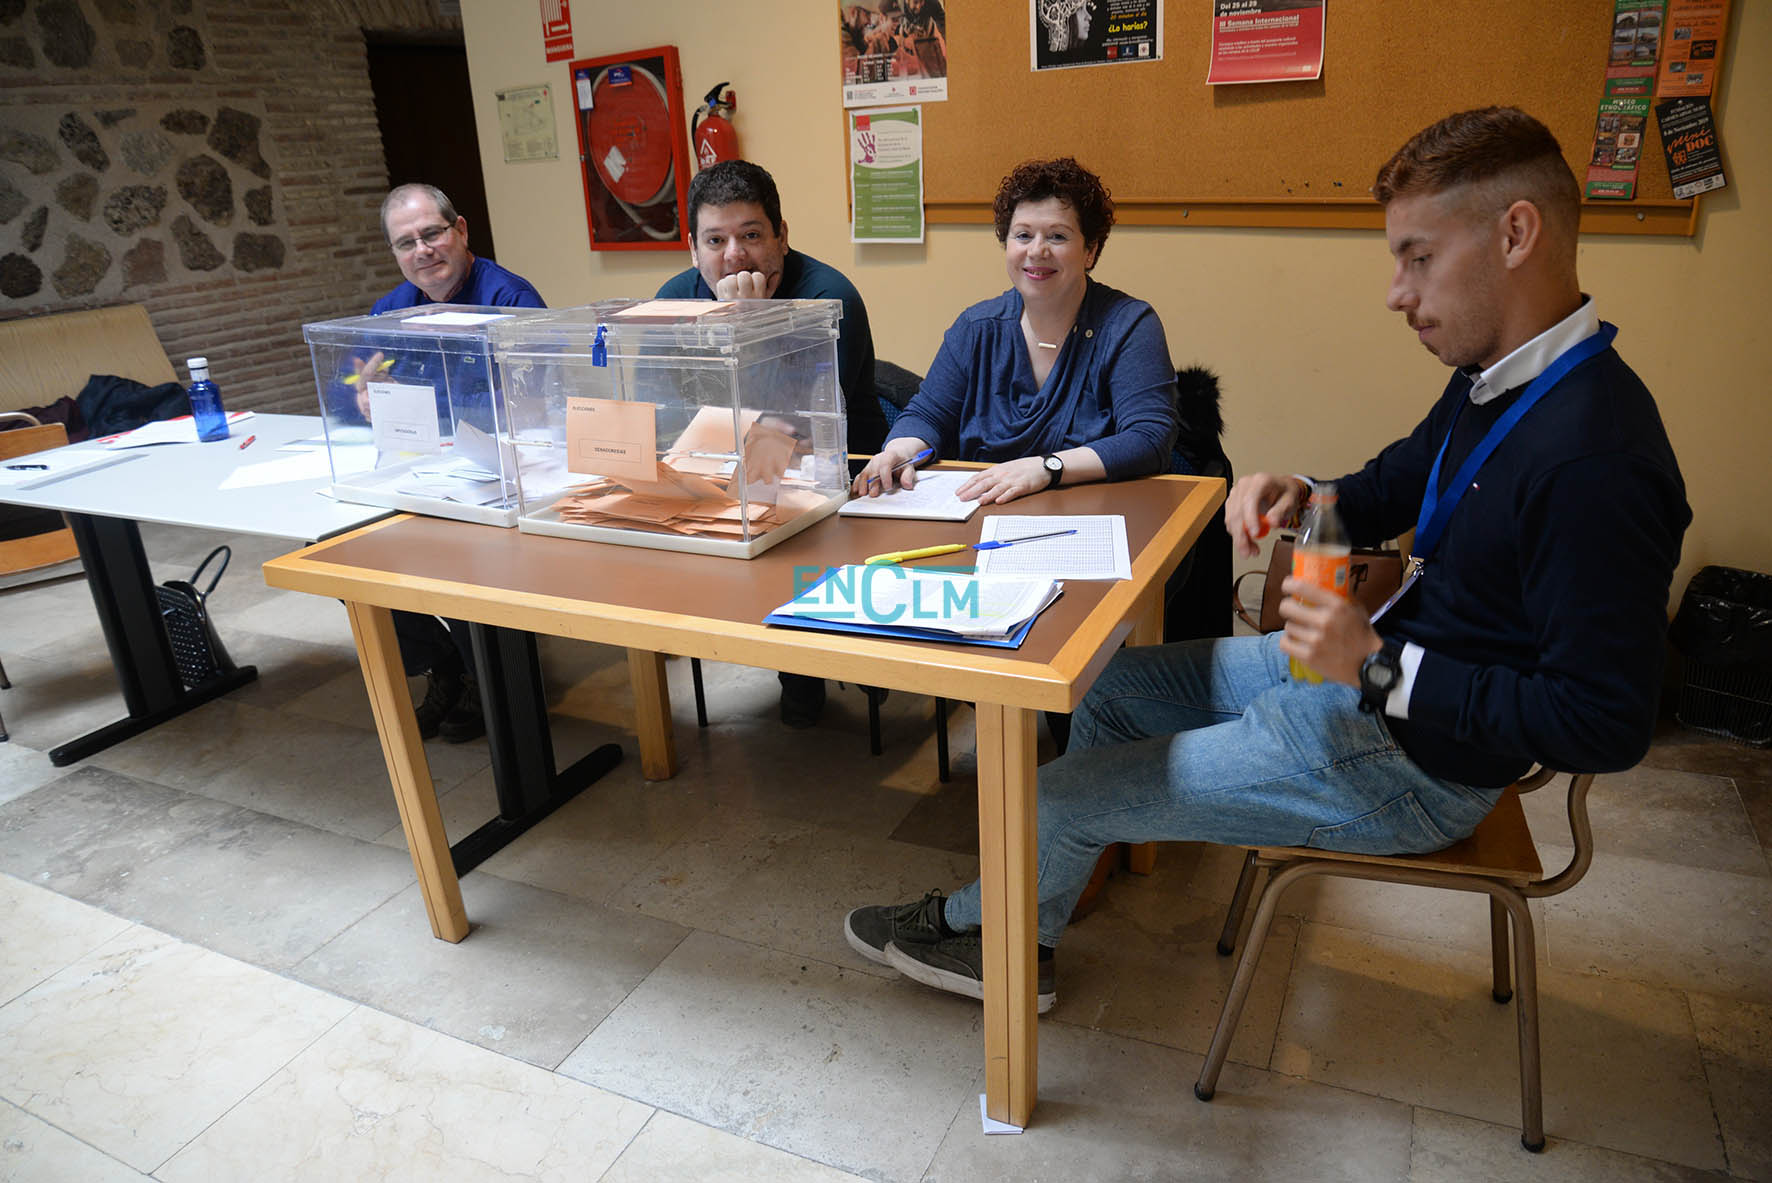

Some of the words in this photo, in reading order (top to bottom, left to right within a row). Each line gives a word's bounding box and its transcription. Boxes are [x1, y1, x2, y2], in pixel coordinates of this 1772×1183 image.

[1229, 8, 1261, 17] noviembre
[1227, 18, 1253, 26] Semana
[1254, 14, 1299, 24] Internacional
[1108, 24, 1121, 33] ¿Lo
[1686, 135, 1714, 153] DOC
